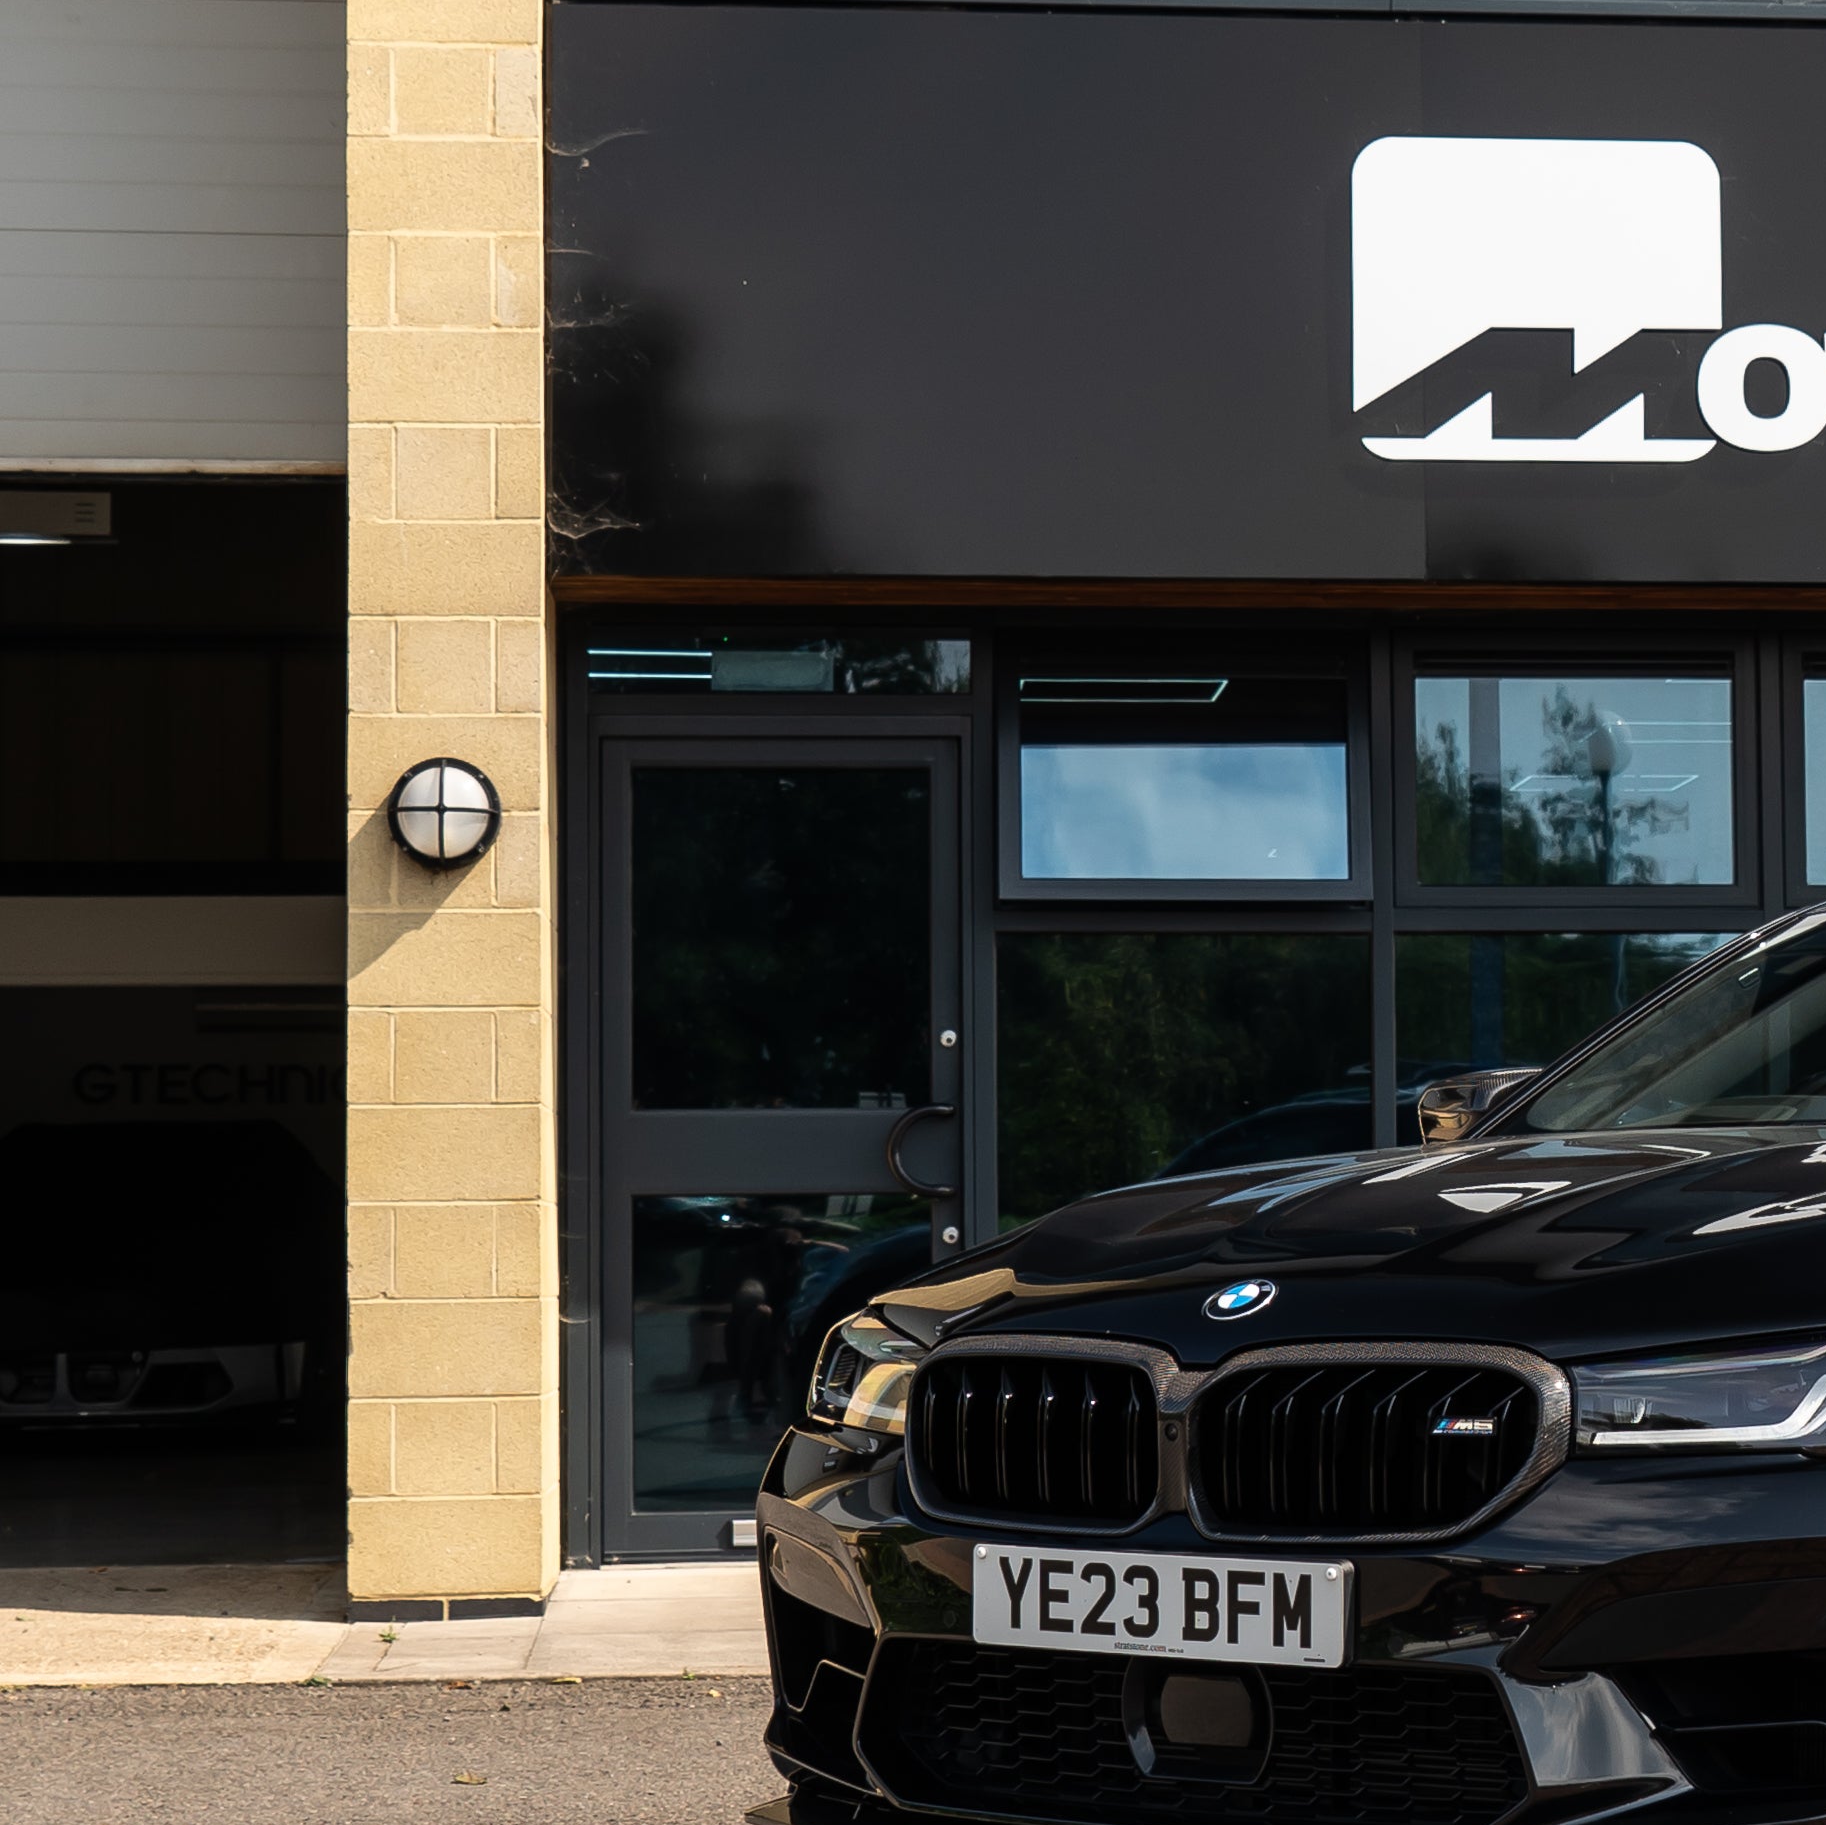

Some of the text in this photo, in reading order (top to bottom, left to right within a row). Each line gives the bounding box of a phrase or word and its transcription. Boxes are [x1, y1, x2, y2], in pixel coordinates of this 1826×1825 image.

[1452, 1418, 1494, 1430] M5
[999, 1555, 1312, 1649] YE23 BFM
